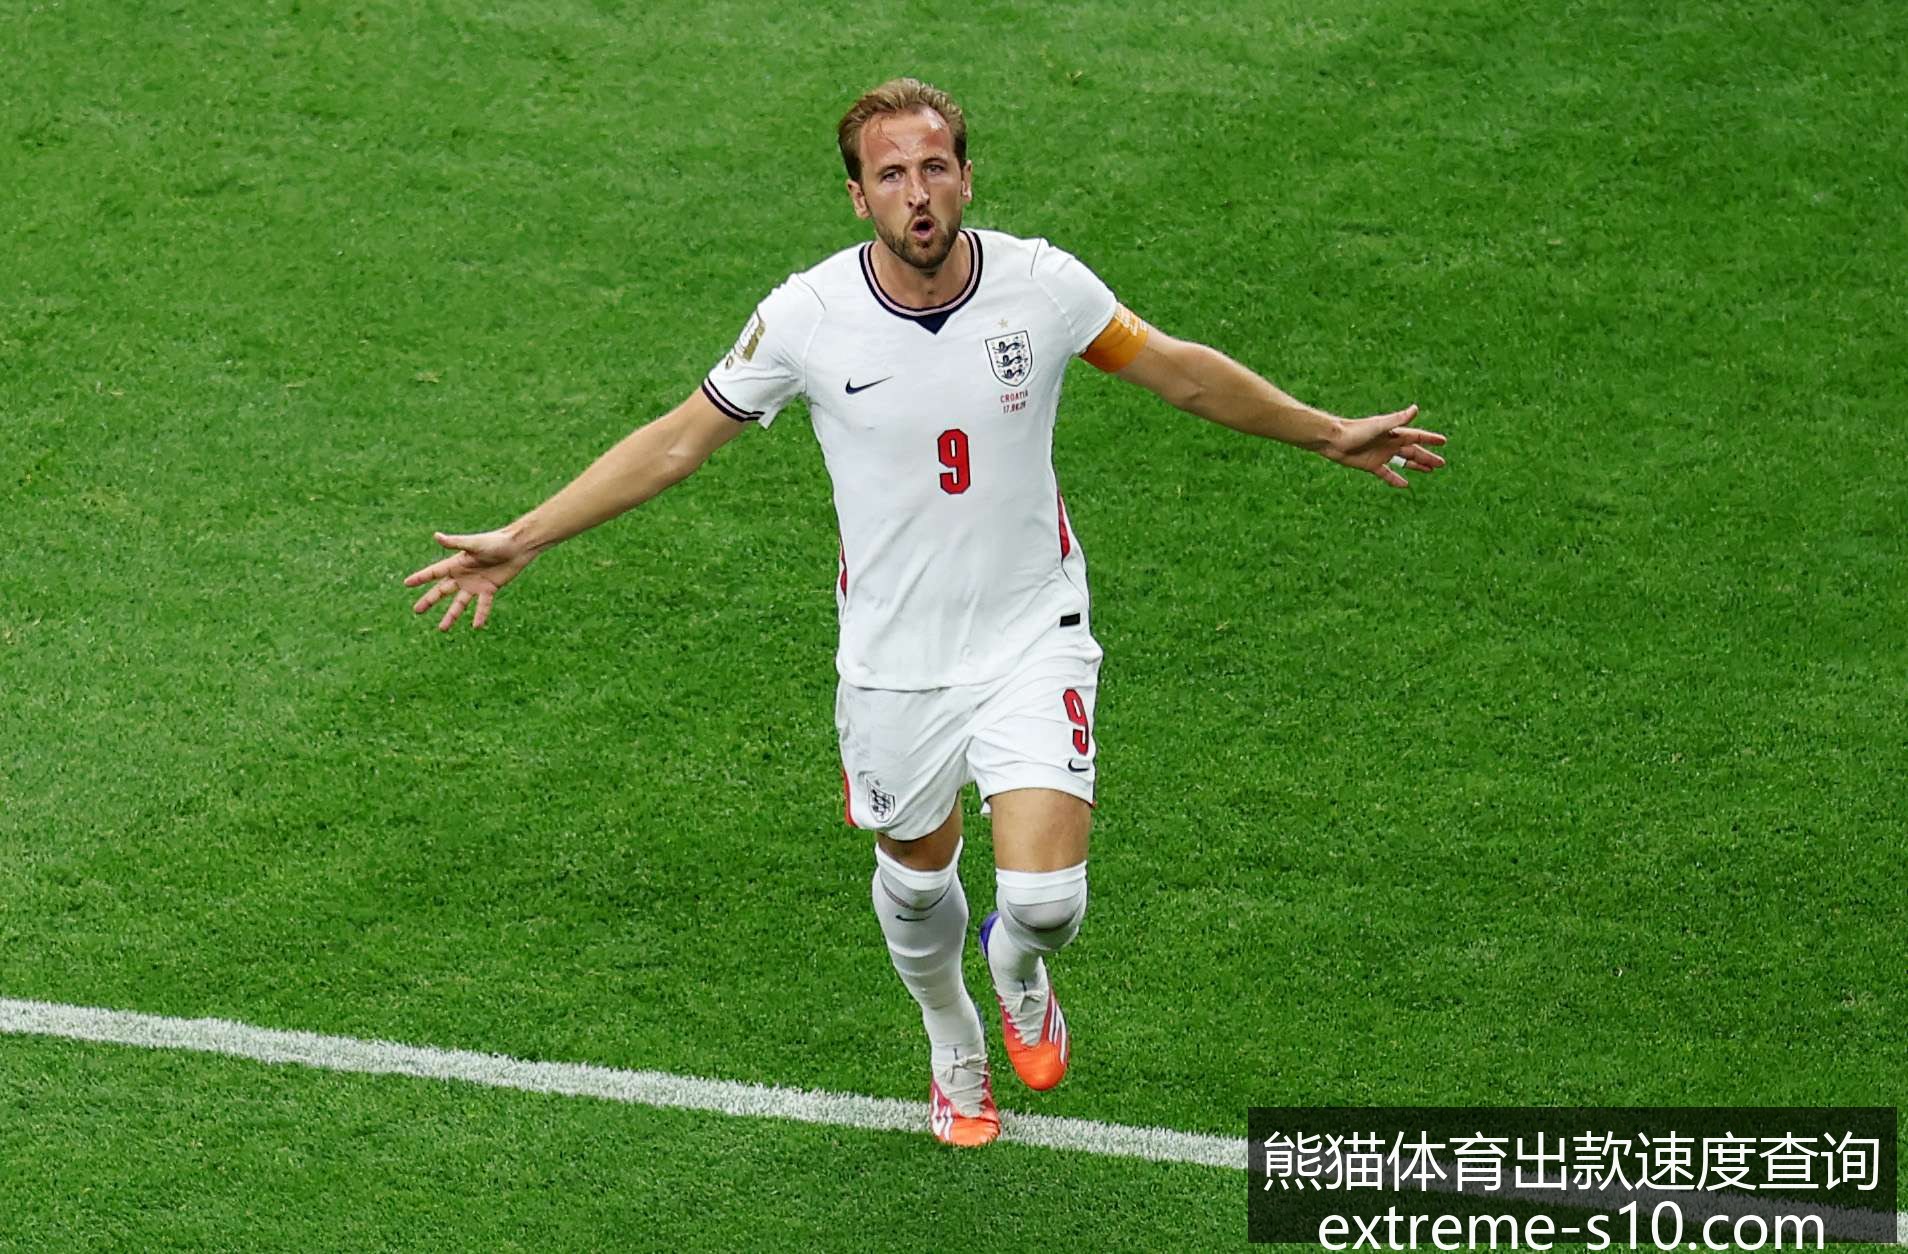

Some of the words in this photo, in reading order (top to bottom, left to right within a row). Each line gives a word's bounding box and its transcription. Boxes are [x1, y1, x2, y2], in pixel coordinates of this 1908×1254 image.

[1000, 389, 1029, 403] CROATIA
[937, 428, 971, 495] 9
[1062, 688, 1090, 756] 9
